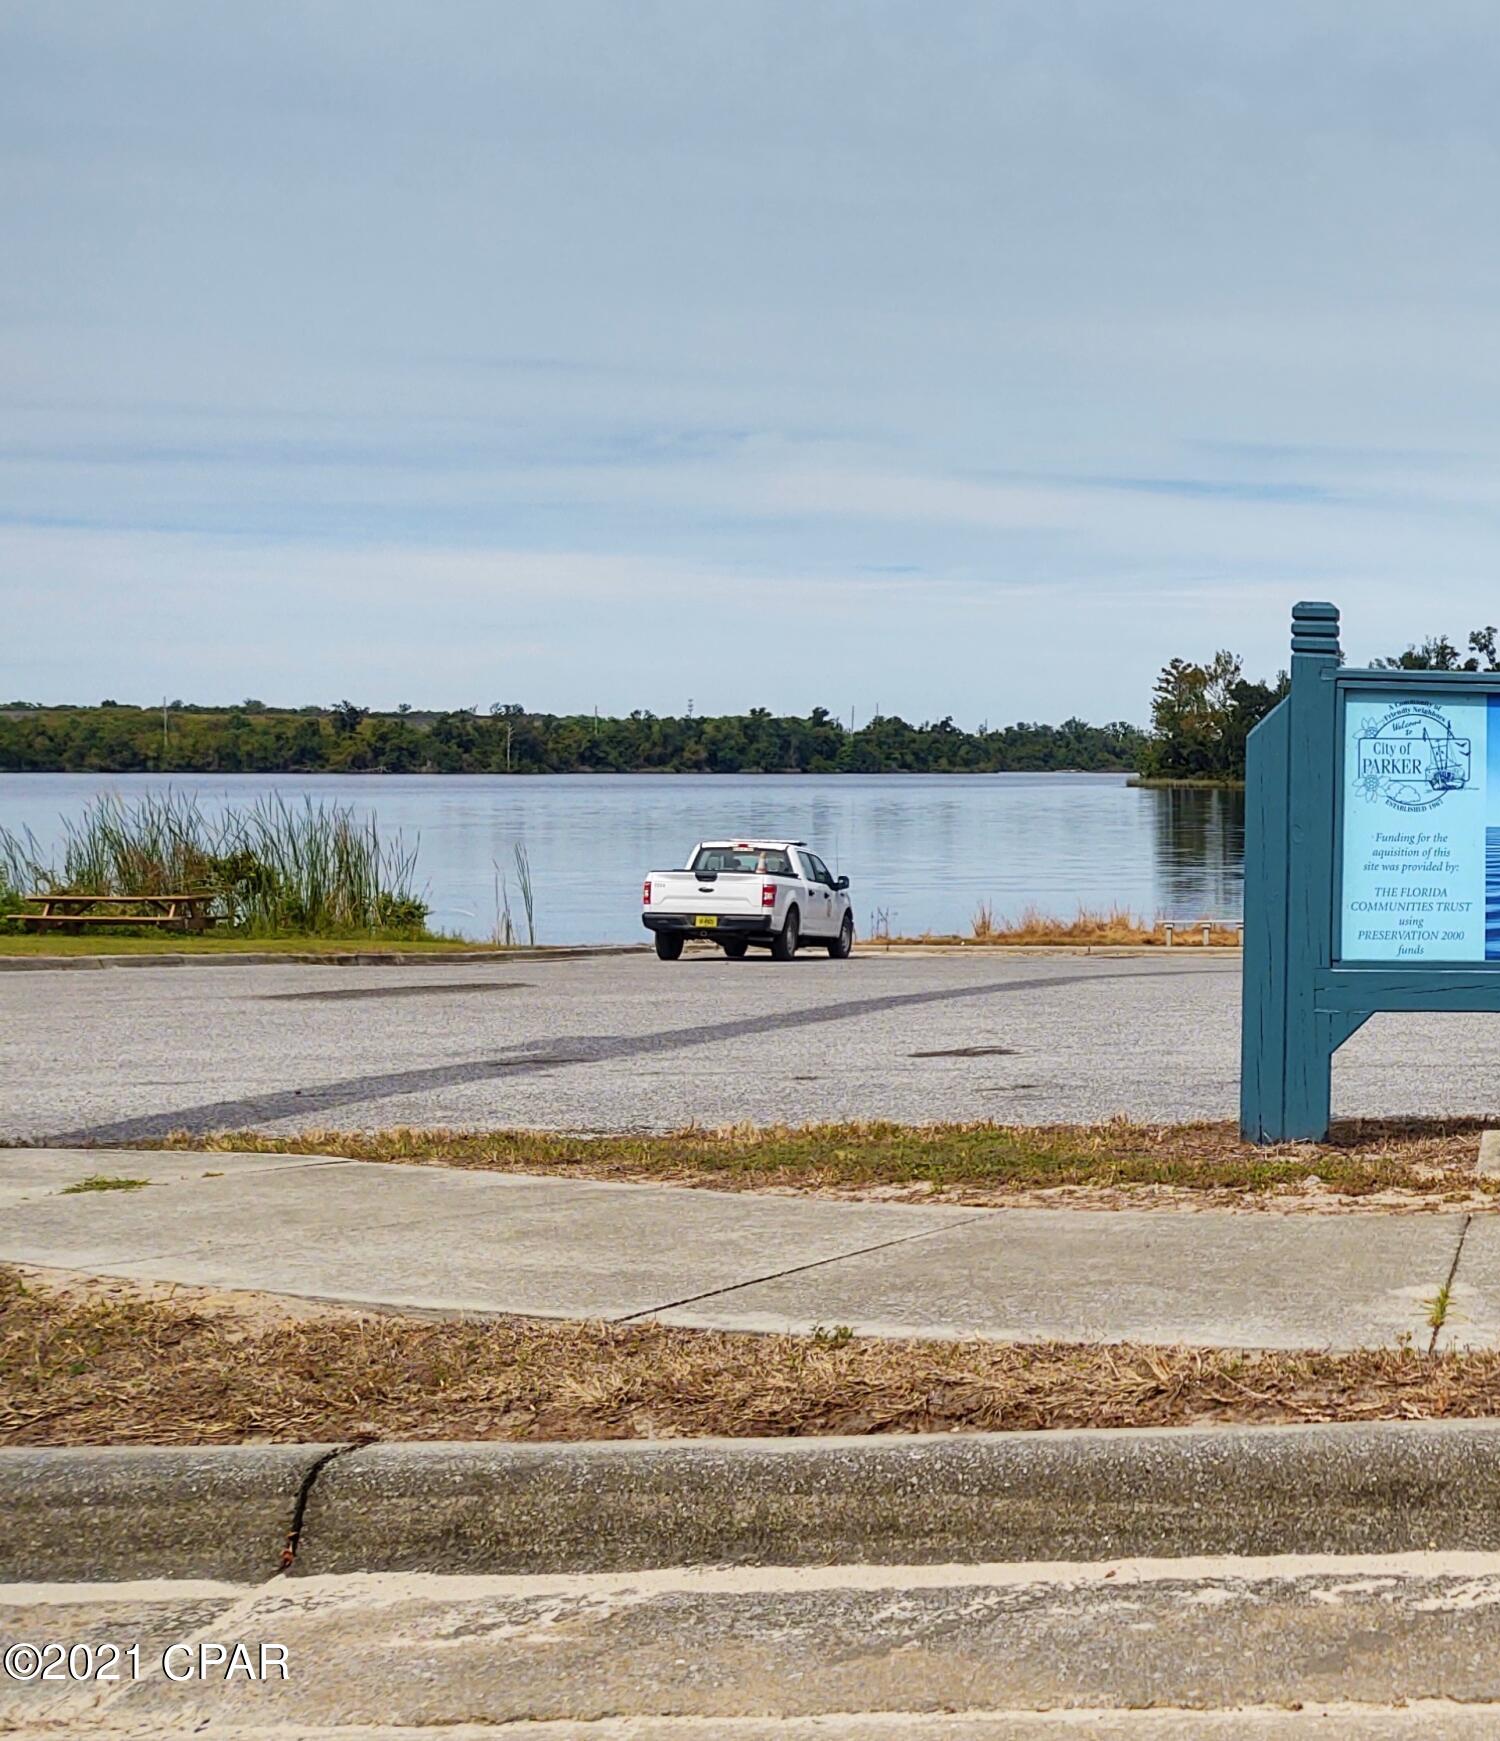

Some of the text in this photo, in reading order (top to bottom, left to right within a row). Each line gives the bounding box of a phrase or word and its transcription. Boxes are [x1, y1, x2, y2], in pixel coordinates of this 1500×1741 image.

[1384, 706, 1446, 721] Friendly Neighbors
[1392, 719, 1422, 732] Welcome
[1373, 742, 1412, 757] City of
[1362, 758, 1422, 775] PARKER
[1375, 832, 1448, 845] Funding for the
[1372, 847, 1451, 859] aquisition of this
[1363, 862, 1460, 874] site was provided by:
[1374, 887, 1448, 898] THE FLORIDA
[1350, 901, 1473, 912] COMMUNITIES TRUST
[1398, 916, 1424, 929] using
[1357, 930, 1465, 941] PRESERVATION 2000
[1396, 944, 1425, 957] funds
